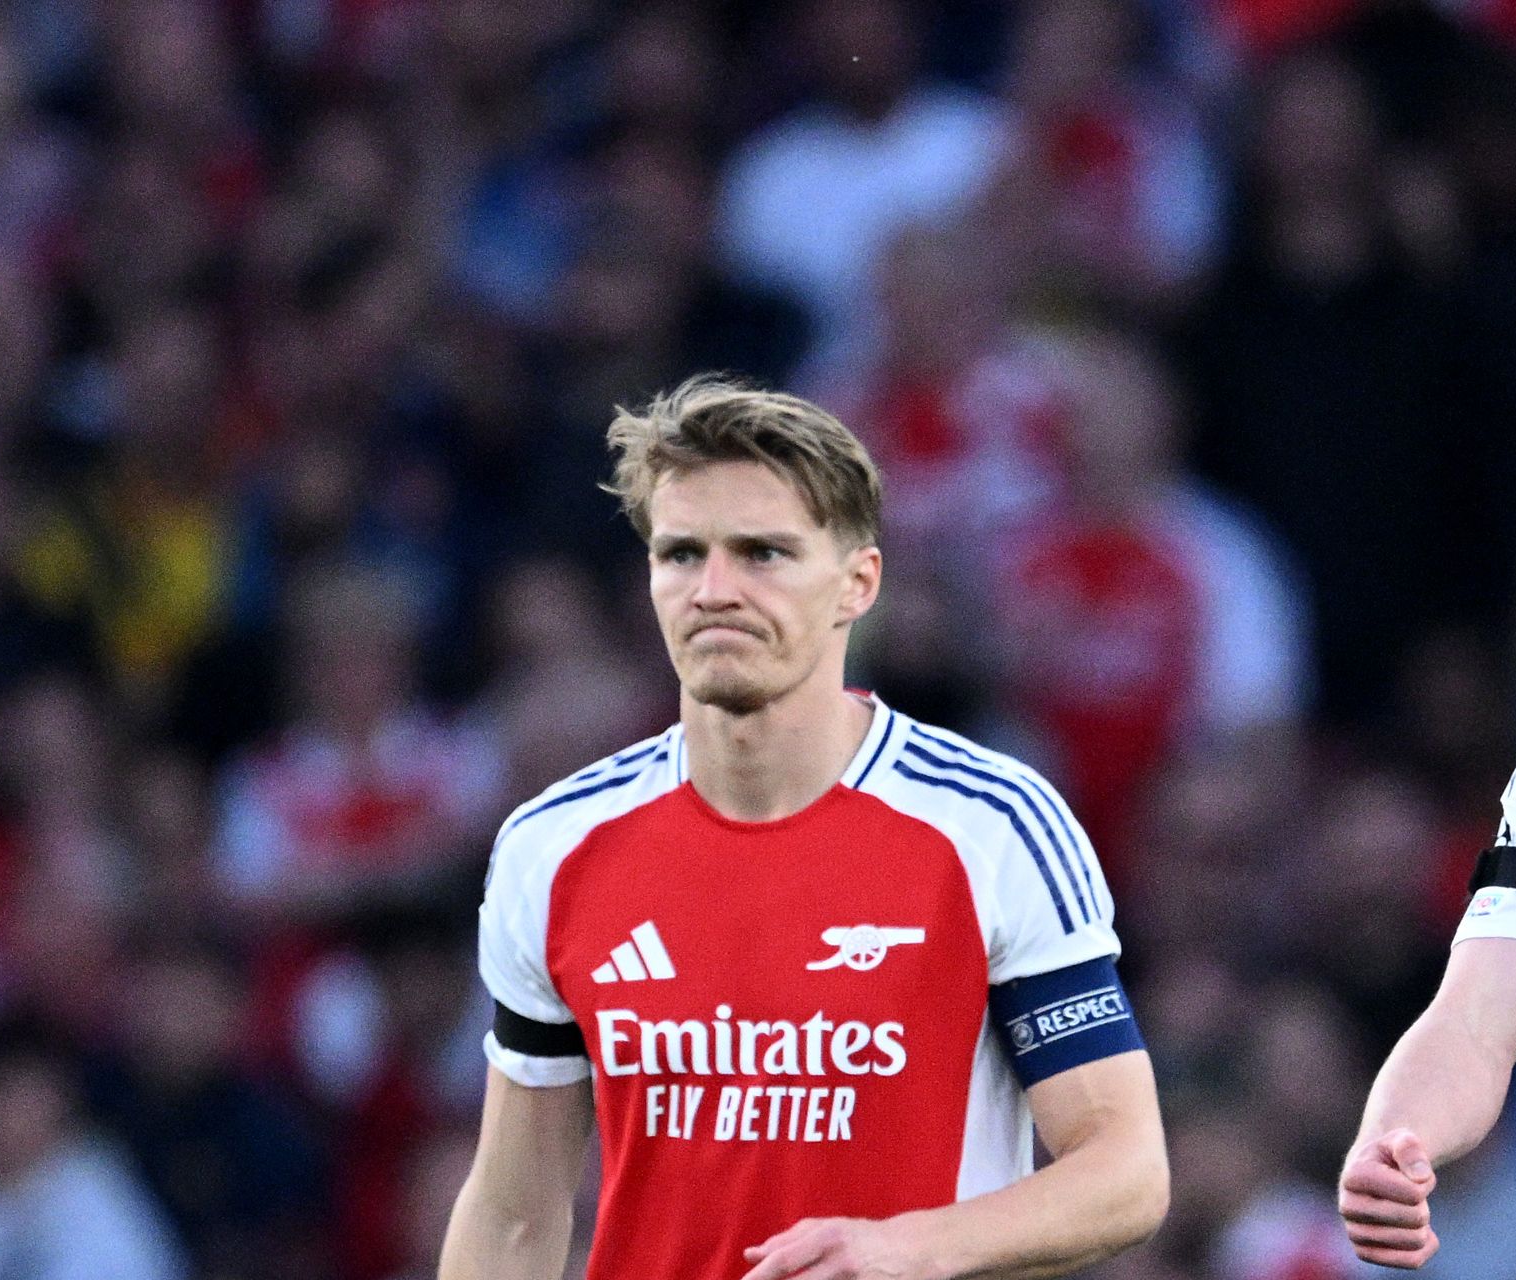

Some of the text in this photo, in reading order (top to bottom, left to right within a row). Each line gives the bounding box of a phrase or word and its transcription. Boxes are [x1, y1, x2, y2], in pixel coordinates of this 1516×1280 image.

[590, 1003, 908, 1080] Emirates
[1035, 992, 1125, 1037] RESPECT
[645, 1084, 856, 1142] FLY BETTER
